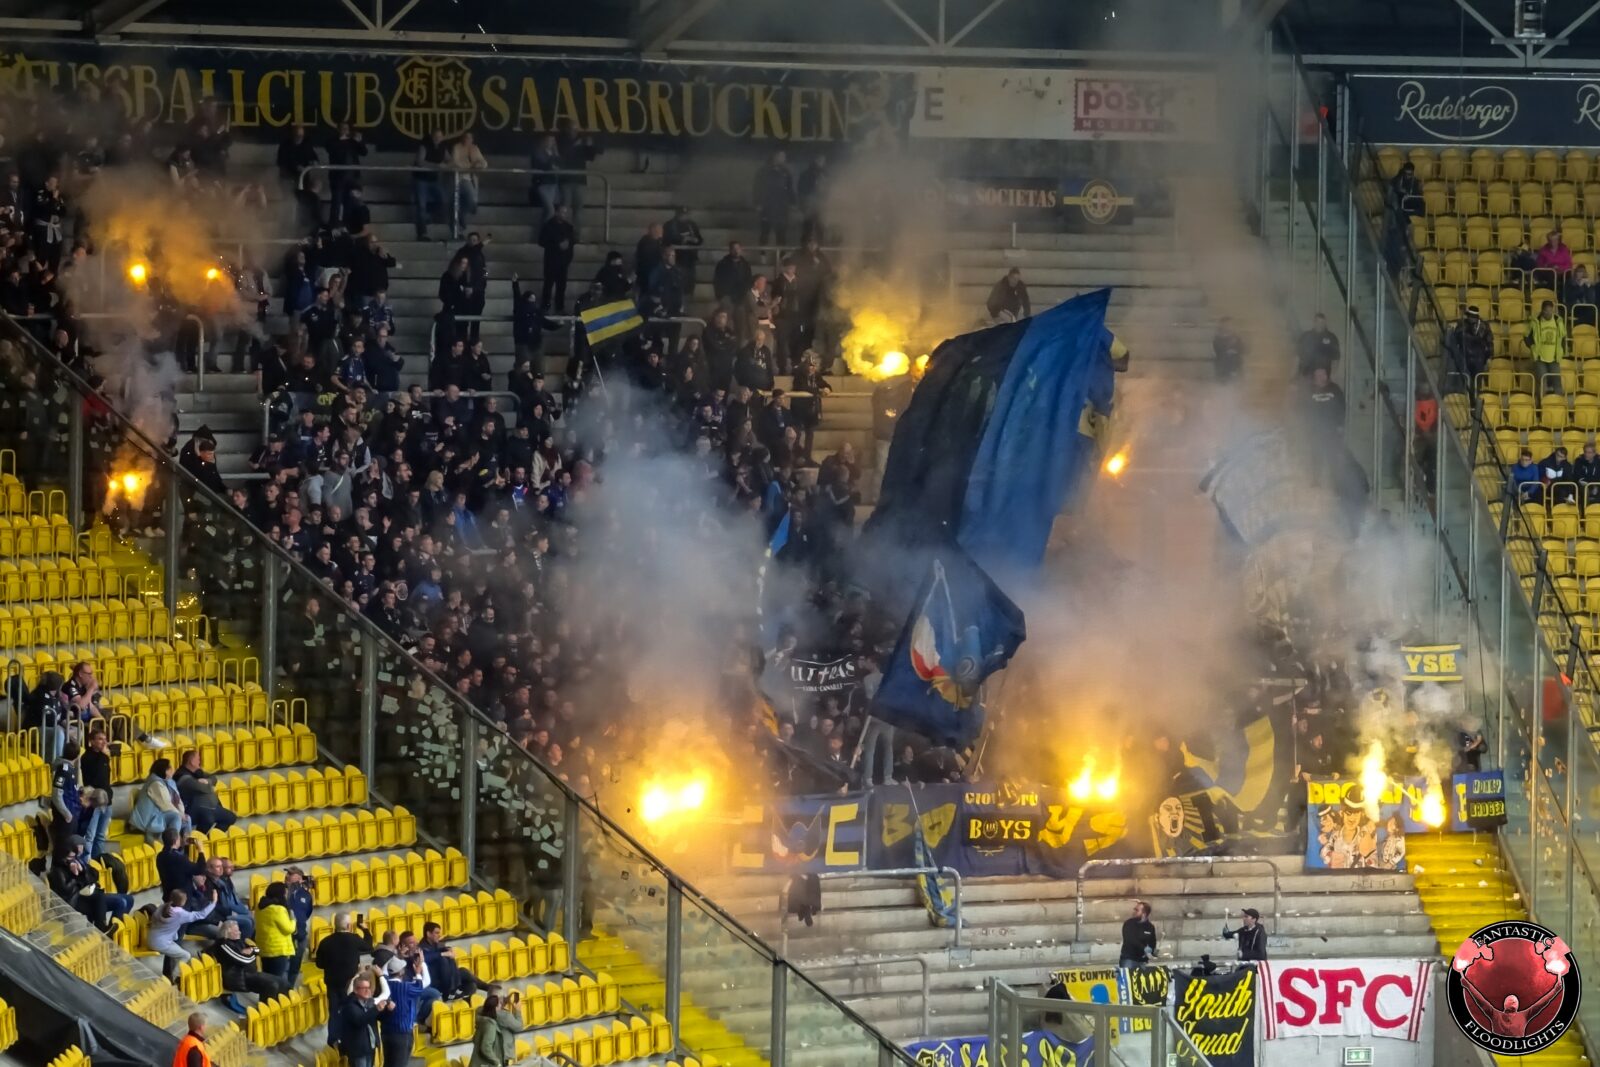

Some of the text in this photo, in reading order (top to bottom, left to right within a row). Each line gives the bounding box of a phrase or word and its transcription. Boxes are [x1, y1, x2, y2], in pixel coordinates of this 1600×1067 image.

[480, 75, 851, 142] SAARBRÜCKEN
[1394, 81, 1518, 138] Radeberger
[974, 187, 1057, 208] SOCIETAS
[1405, 653, 1457, 673] YSB
[1177, 970, 1253, 1022] Youth
[1275, 967, 1413, 1029] SFC
